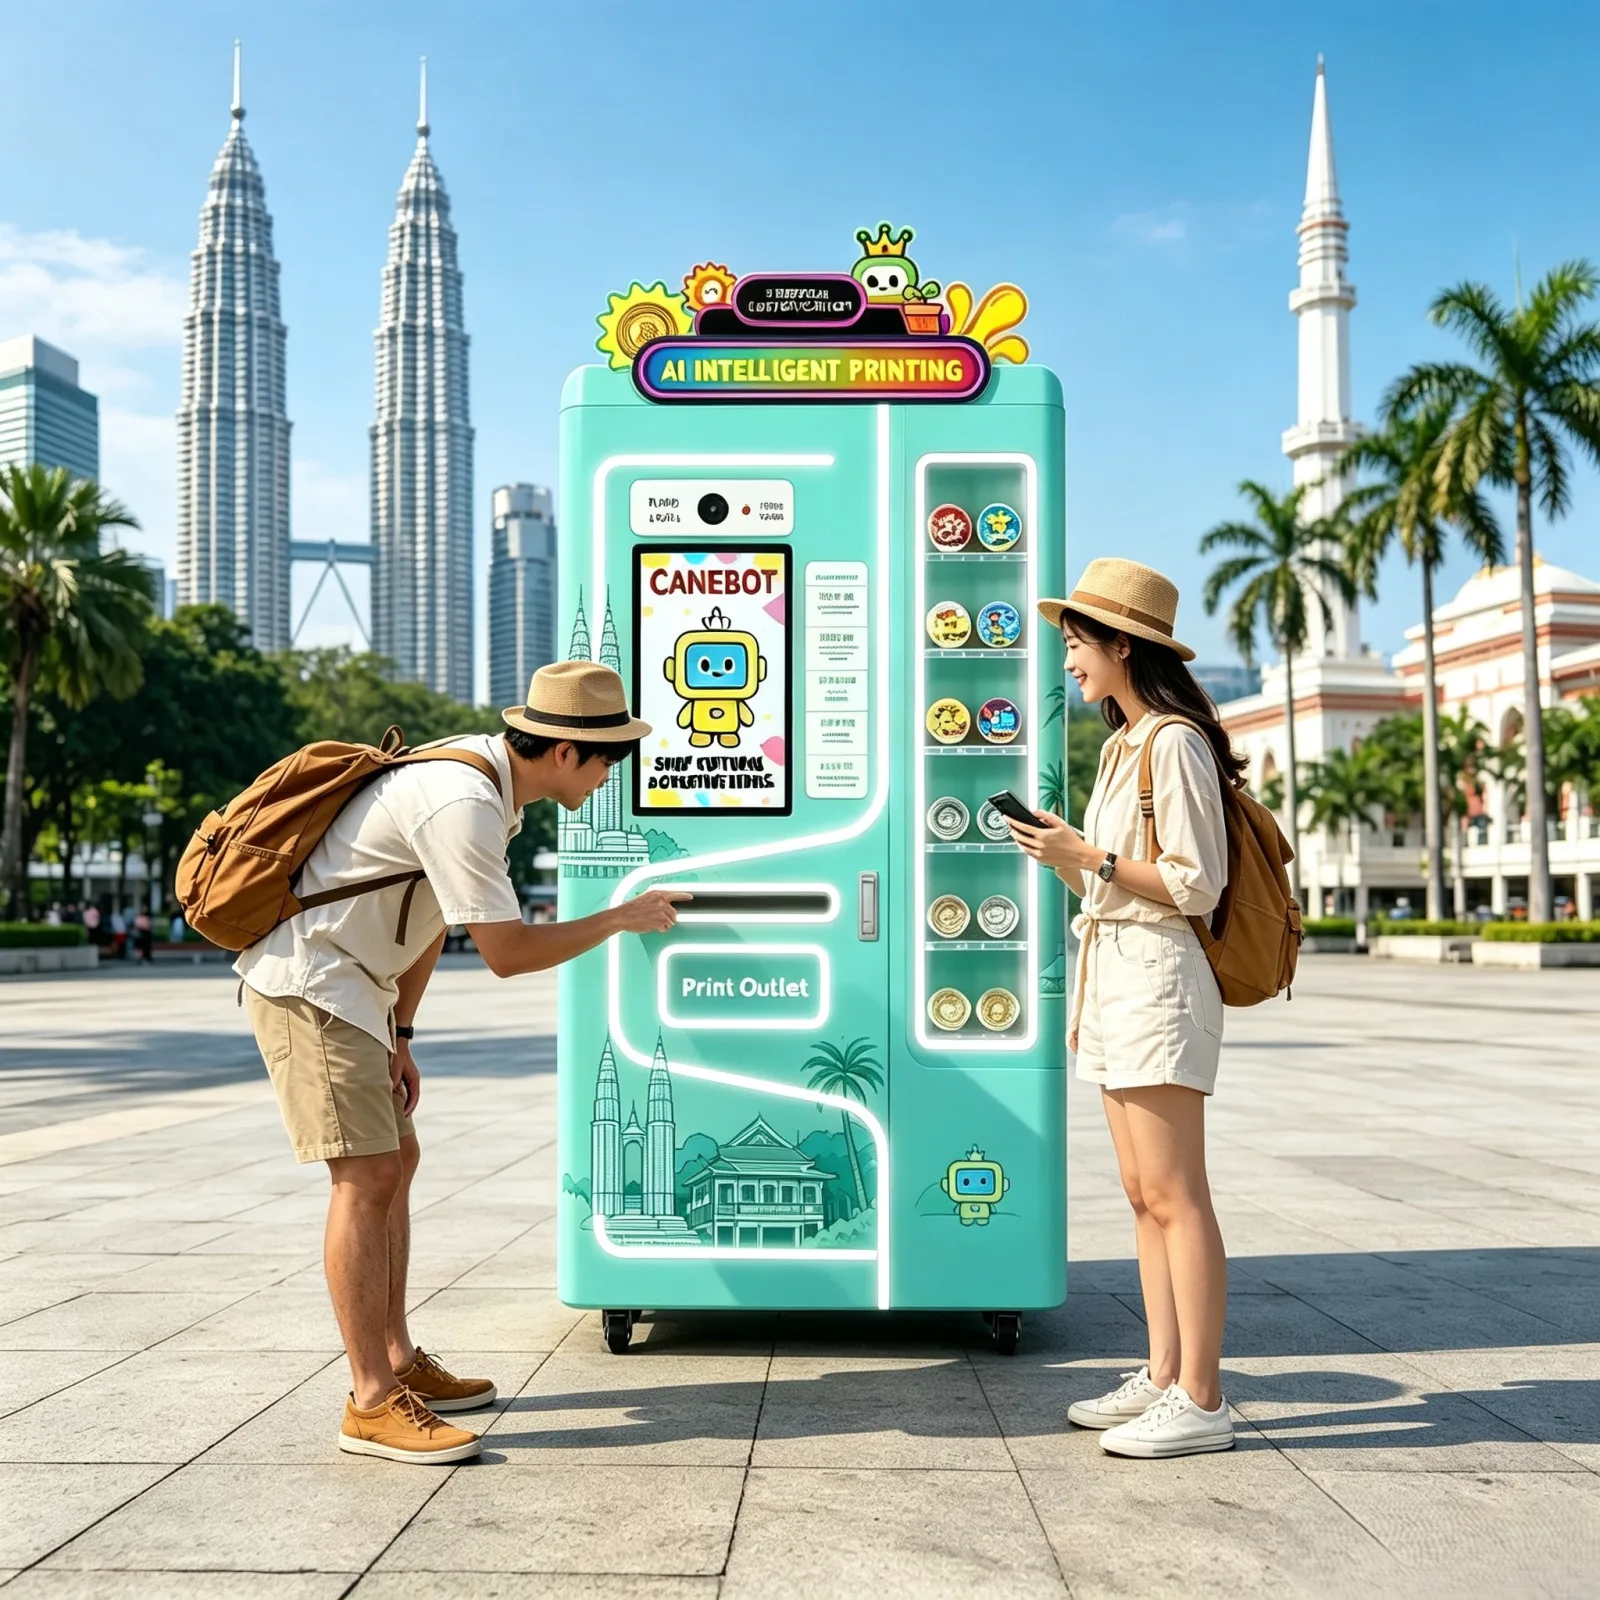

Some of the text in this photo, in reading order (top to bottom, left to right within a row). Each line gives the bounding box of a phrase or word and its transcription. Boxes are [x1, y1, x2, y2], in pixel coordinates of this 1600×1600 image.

[660, 359, 964, 382] AI INTELLIGENT PRINTING
[649, 568, 778, 596] CANEBOT
[682, 977, 809, 998] Print Outlet
